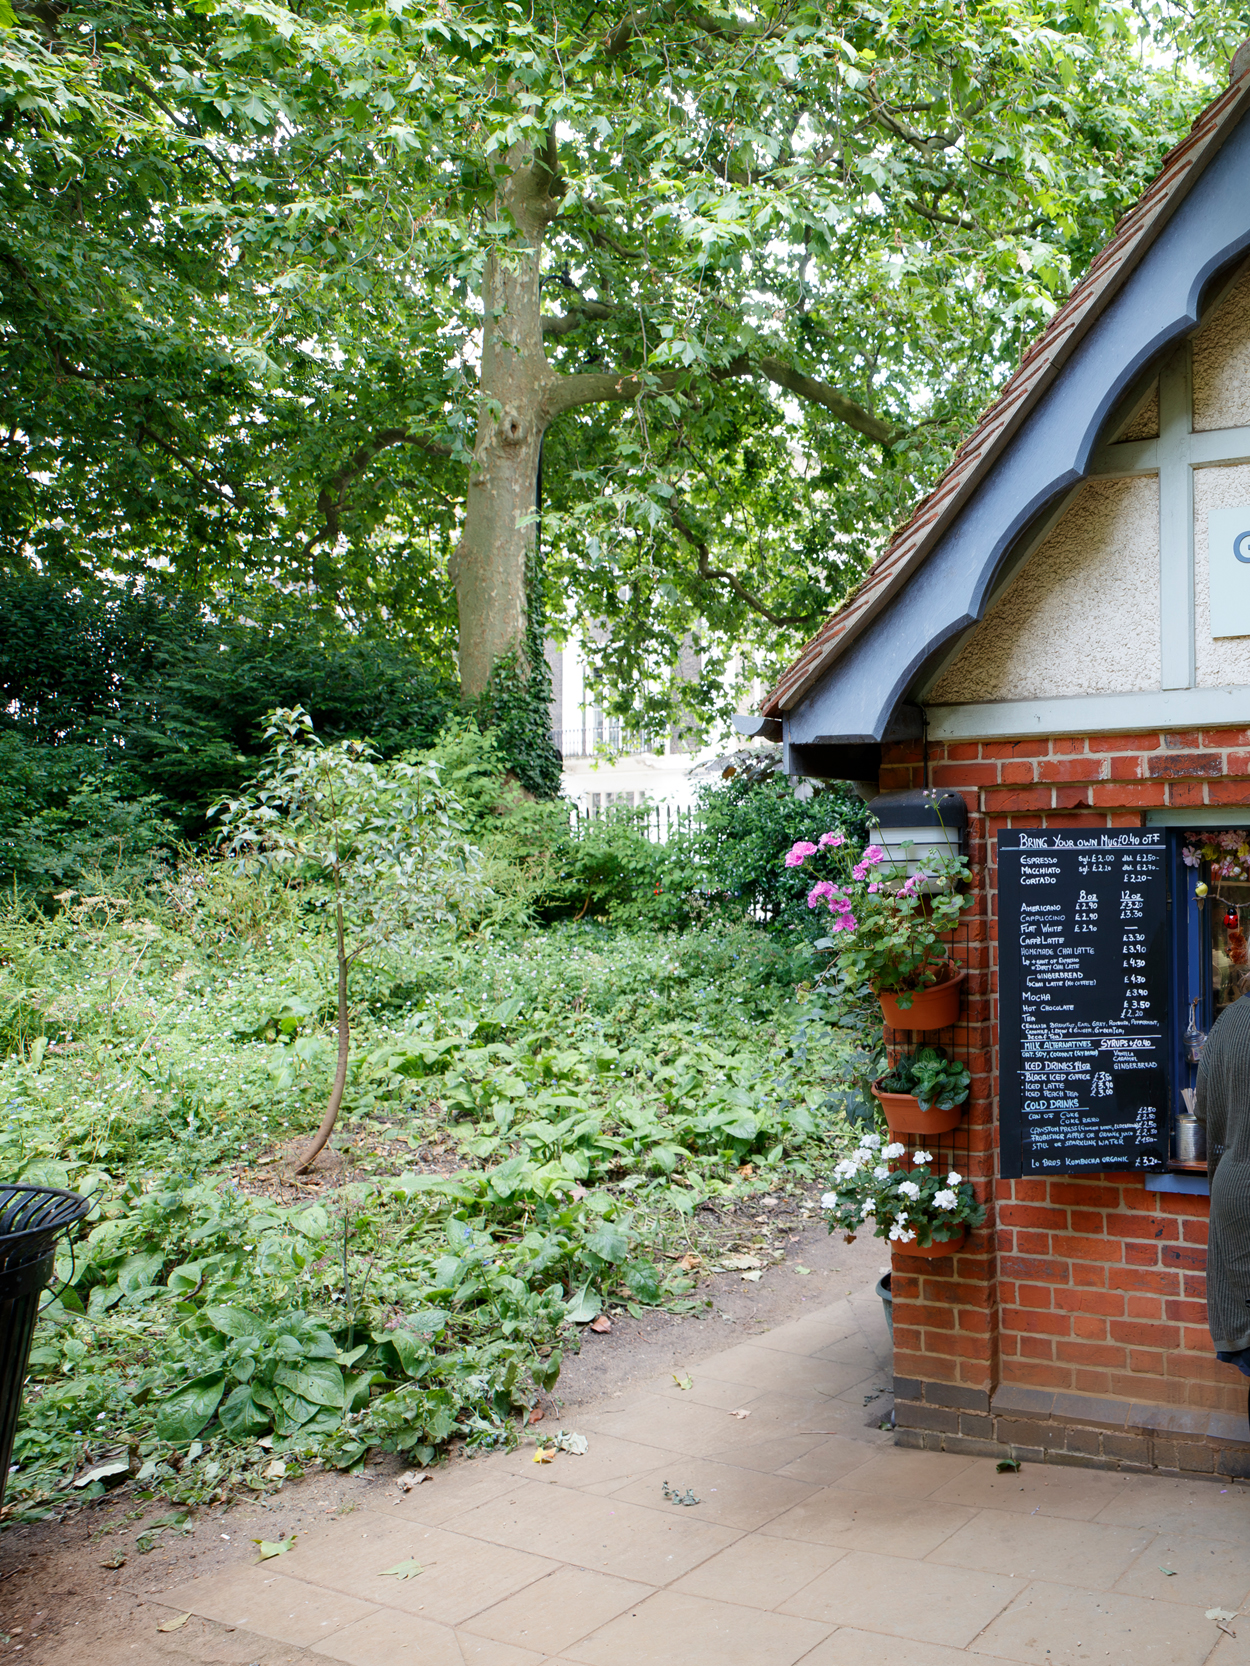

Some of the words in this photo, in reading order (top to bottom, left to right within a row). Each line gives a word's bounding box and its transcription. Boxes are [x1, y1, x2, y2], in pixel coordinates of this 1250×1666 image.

[1019, 833, 1047, 848] BRING
[1053, 834, 1074, 847] YOUR
[1020, 855, 1057, 864] ESPRESSO
[1021, 866, 1061, 874] MACCHIATO
[1021, 903, 1061, 912] AMERICANO
[1020, 914, 1065, 922] CAPPUCCINO
[1021, 924, 1037, 933] FLAT
[1041, 924, 1063, 933] WHITE
[1021, 947, 1054, 955] HOMEMADE
[1022, 992, 1050, 1001] MOCHA
[1044, 1041, 1091, 1049] ALTERNATIVES
[1101, 1039, 1128, 1048] SYRUPS
[1025, 1062, 1042, 1070] ICED
[1045, 1061, 1073, 1070] DRINKS
[1025, 1101, 1047, 1110] COLD
[1049, 1099, 1079, 1108] DRINKS
